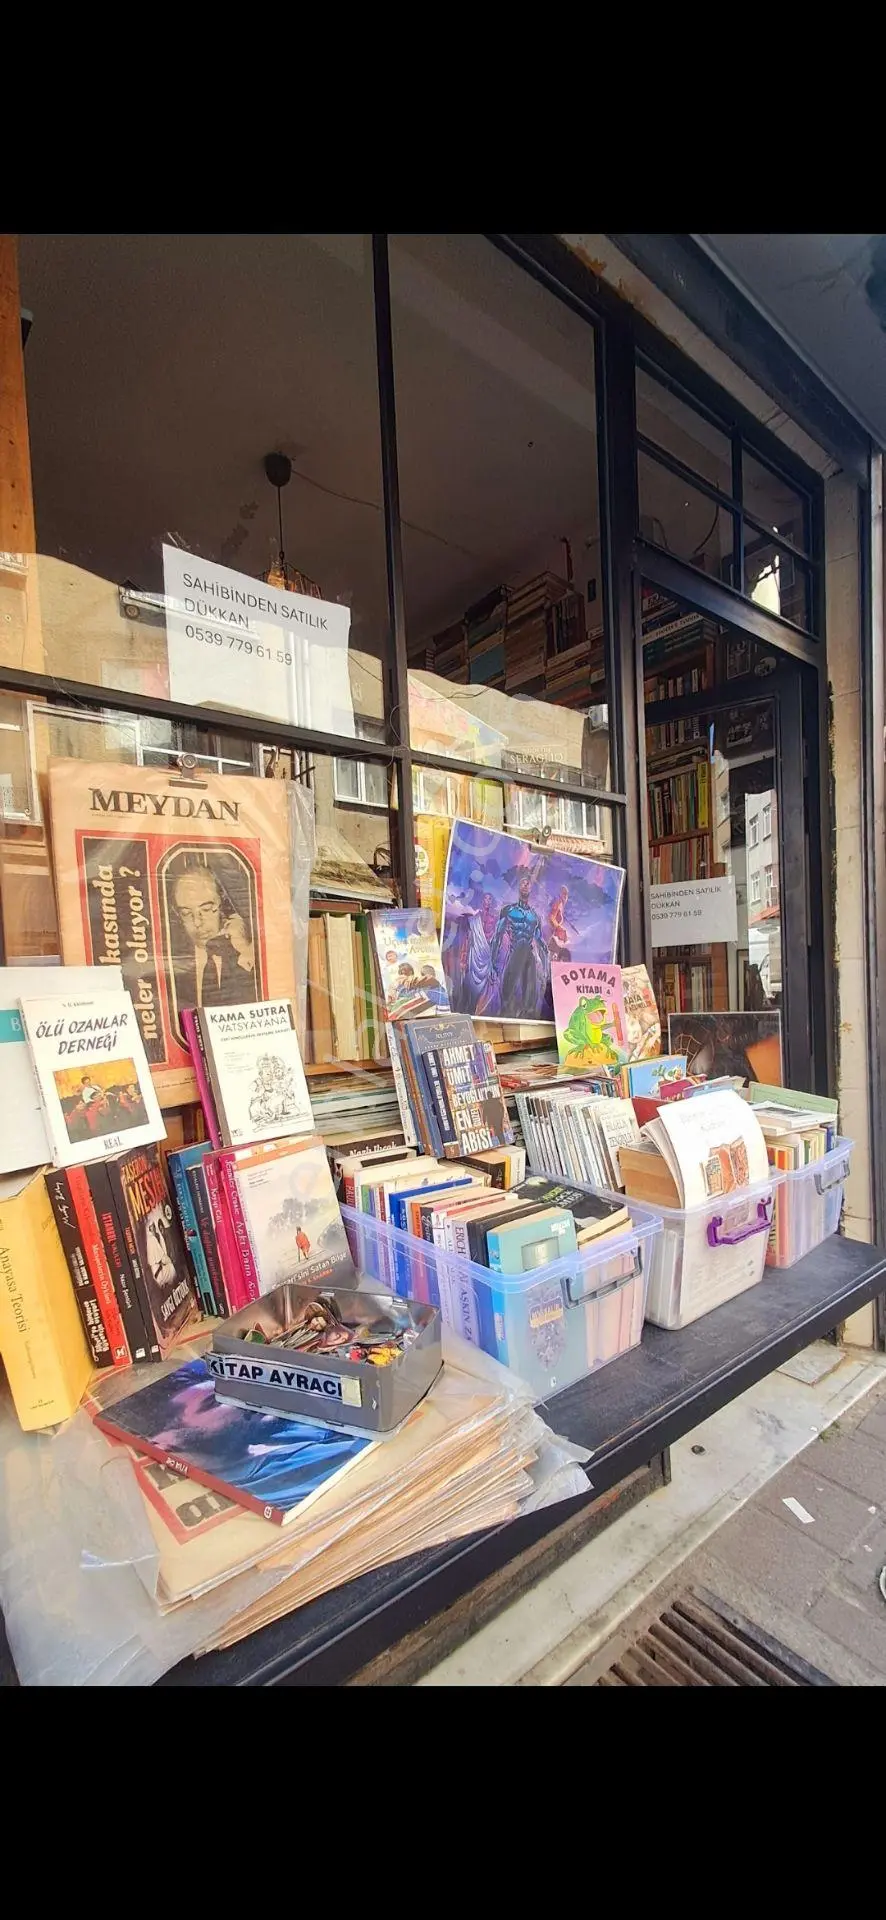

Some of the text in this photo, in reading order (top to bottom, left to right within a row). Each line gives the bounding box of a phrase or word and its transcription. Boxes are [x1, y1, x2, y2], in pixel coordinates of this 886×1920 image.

[183, 573, 328, 631] SAHİBİNDEN SATILIK
[184, 597, 249, 629] DÜKKAN
[185, 624, 292, 666] 0539 779 61 59
[88, 788, 240, 822] MEYDAN
[651, 889, 694, 899] SAHİBİNDEN
[126, 886, 151, 963] oluyor
[561, 968, 616, 988] BOYAMA
[576, 985, 602, 994] KİTABI
[134, 979, 158, 1040] neler
[210, 1005, 286, 1023] KAMA SUTRA
[36, 1014, 128, 1039] ÖLÜ OZANLAR
[217, 1016, 288, 1033] VATSYAYANA
[58, 1031, 118, 1055] DERNEĞİ
[443, 1045, 475, 1065] AHMET
[447, 1065, 472, 1085] ÜMİT
[456, 1108, 472, 1131] EN
[103, 1136, 123, 1150] REAL
[461, 1128, 493, 1154] ABİSİ
[210, 1187, 221, 1209] Kayıp
[456, 1227, 467, 1258] ERICH
[310, 1260, 330, 1274] Satan
[331, 1251, 347, 1265] Bilge
[11, 1295, 29, 1334] Teorisi
[209, 1356, 342, 1398] KİTAP AYRACI
